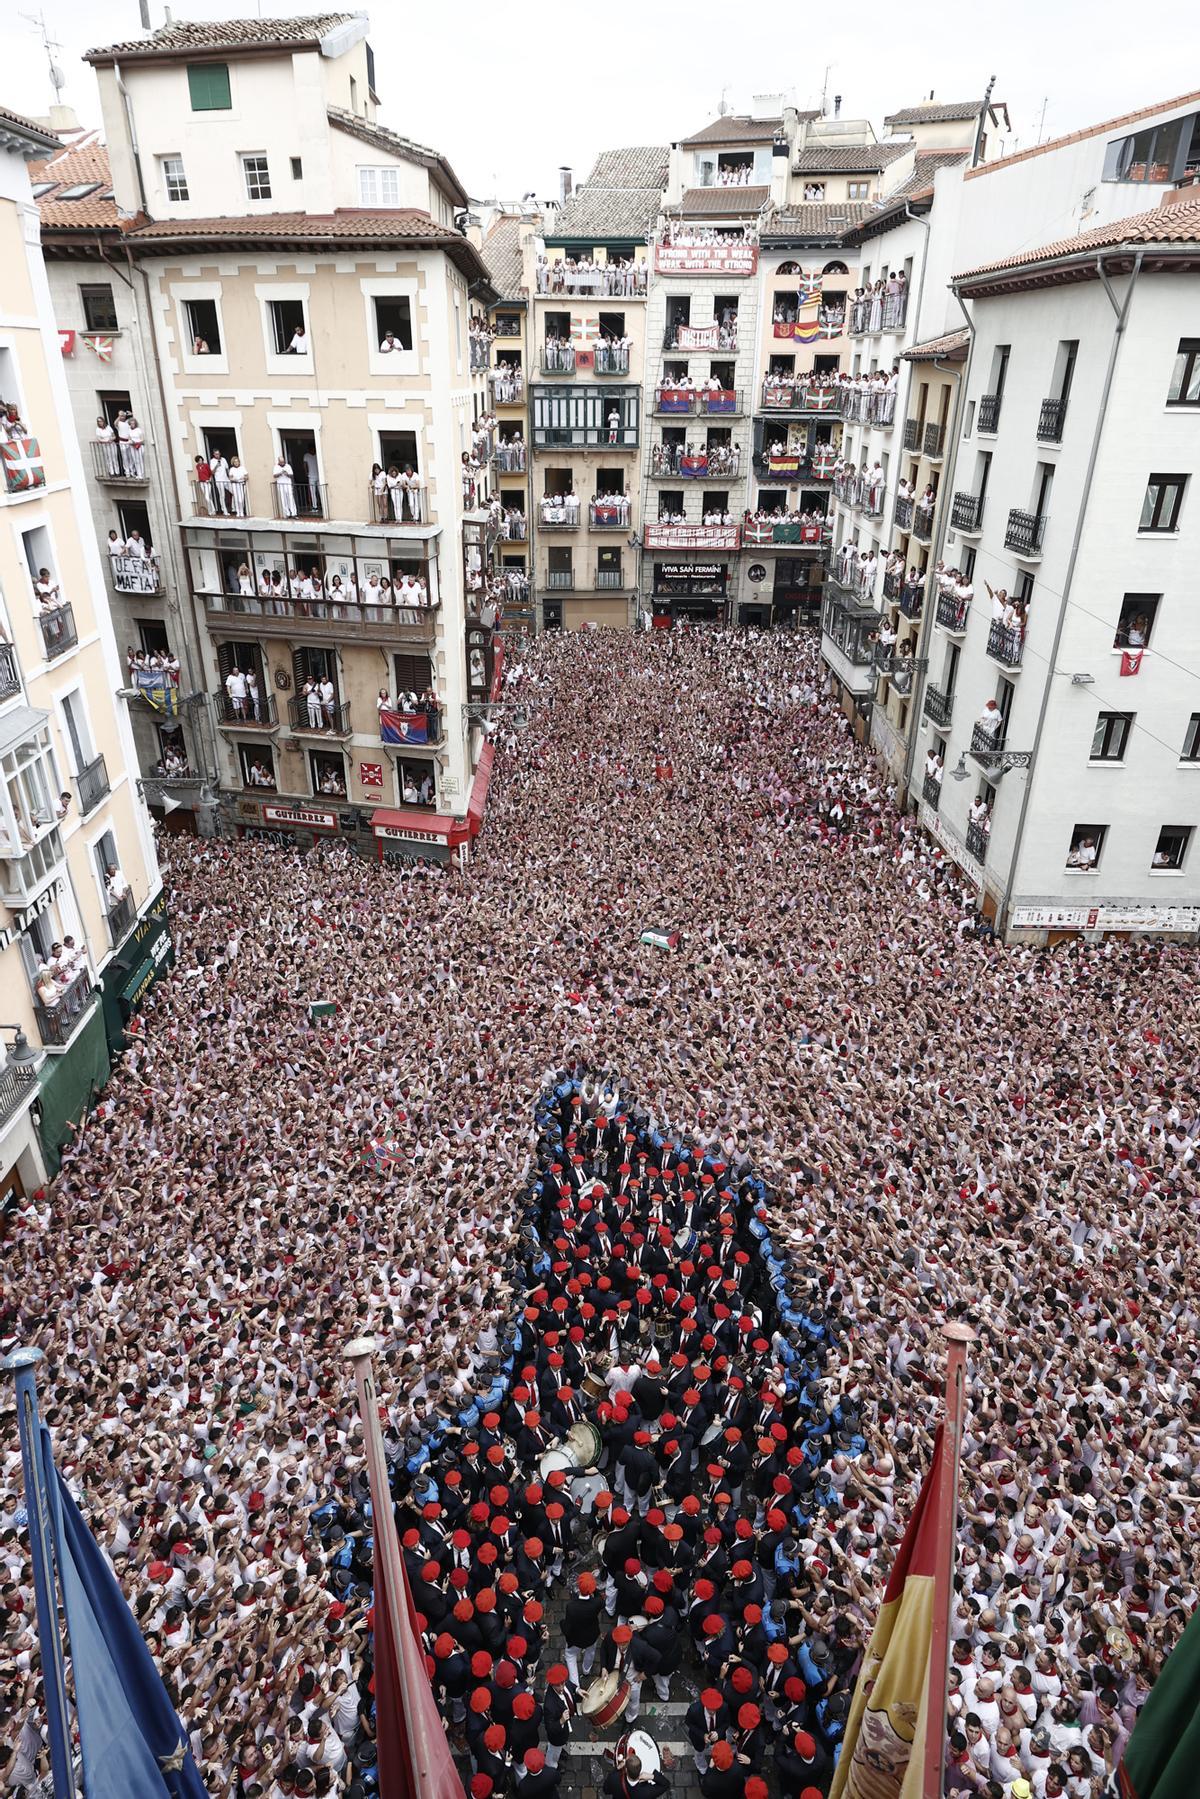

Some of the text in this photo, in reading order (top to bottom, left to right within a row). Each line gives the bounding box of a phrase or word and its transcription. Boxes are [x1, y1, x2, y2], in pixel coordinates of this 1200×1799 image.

[659, 249, 688, 259] STRONG
[691, 249, 710, 259] WITH
[713, 249, 728, 259] THE
[659, 260, 752, 269] WEAK WITH THE STRONG
[117, 575, 153, 591] MAFIA
[752, 592, 759, 600] 2
[275, 810, 326, 823] GUTIERREZ
[385, 828, 438, 842] GUTIERREZ
